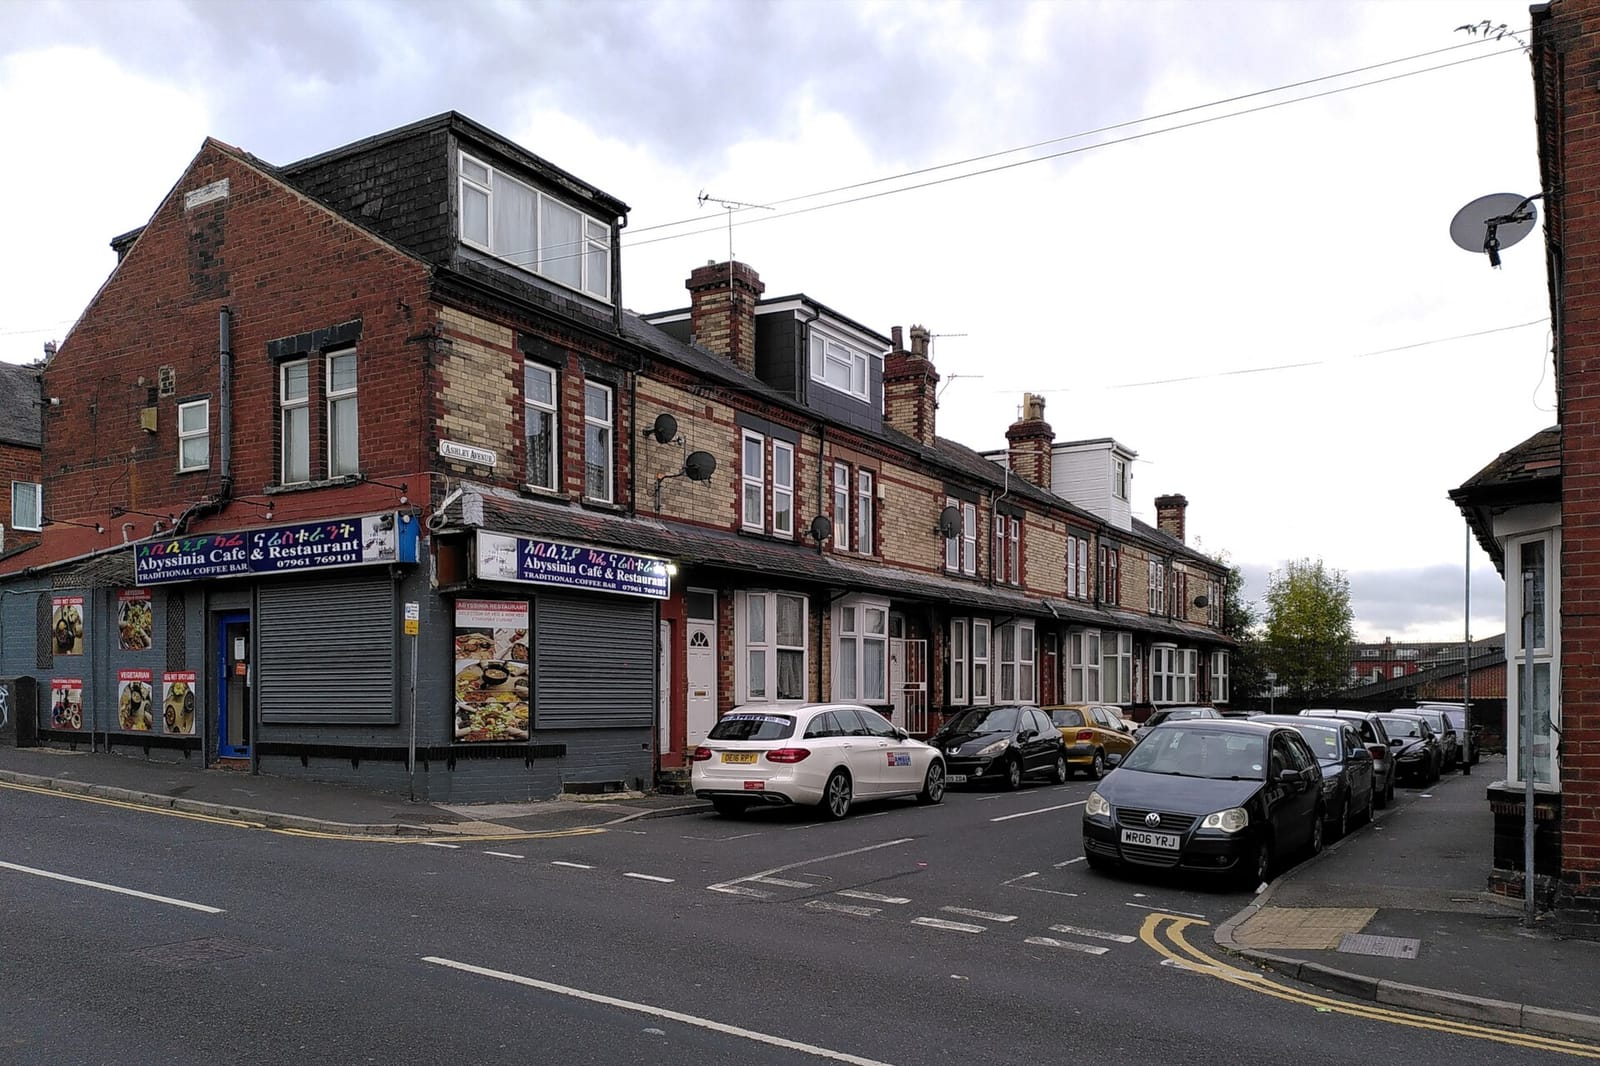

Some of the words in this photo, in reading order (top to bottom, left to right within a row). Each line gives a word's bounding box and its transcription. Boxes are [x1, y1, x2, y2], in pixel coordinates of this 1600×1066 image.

[137, 552, 205, 571] Abyssinia
[210, 547, 246, 562] Cafe
[250, 547, 265, 560] &
[269, 538, 359, 559] Restaurant
[276, 558, 310, 568] 07961
[314, 553, 357, 565] 769101
[139, 568, 192, 581] TRADITIONAL
[193, 564, 228, 575] COFFEE
[229, 562, 248, 572] BAR
[524, 556, 576, 574] Abyssinia
[579, 564, 602, 578] Café
[604, 568, 614, 580] &
[616, 570, 666, 587] Restaurant
[524, 571, 573, 584] TRADITIONAL
[574, 578, 601, 588] COFFEE
[602, 581, 616, 589] BAR
[622, 584, 642, 593] 07961
[458, 601, 489, 609] ABYSSINIA
[489, 603, 527, 611] RESTAURANT
[120, 671, 150, 679] VEGETARIAN
[1125, 831, 1152, 845] WR06
[1156, 834, 1176, 847] YRJ
